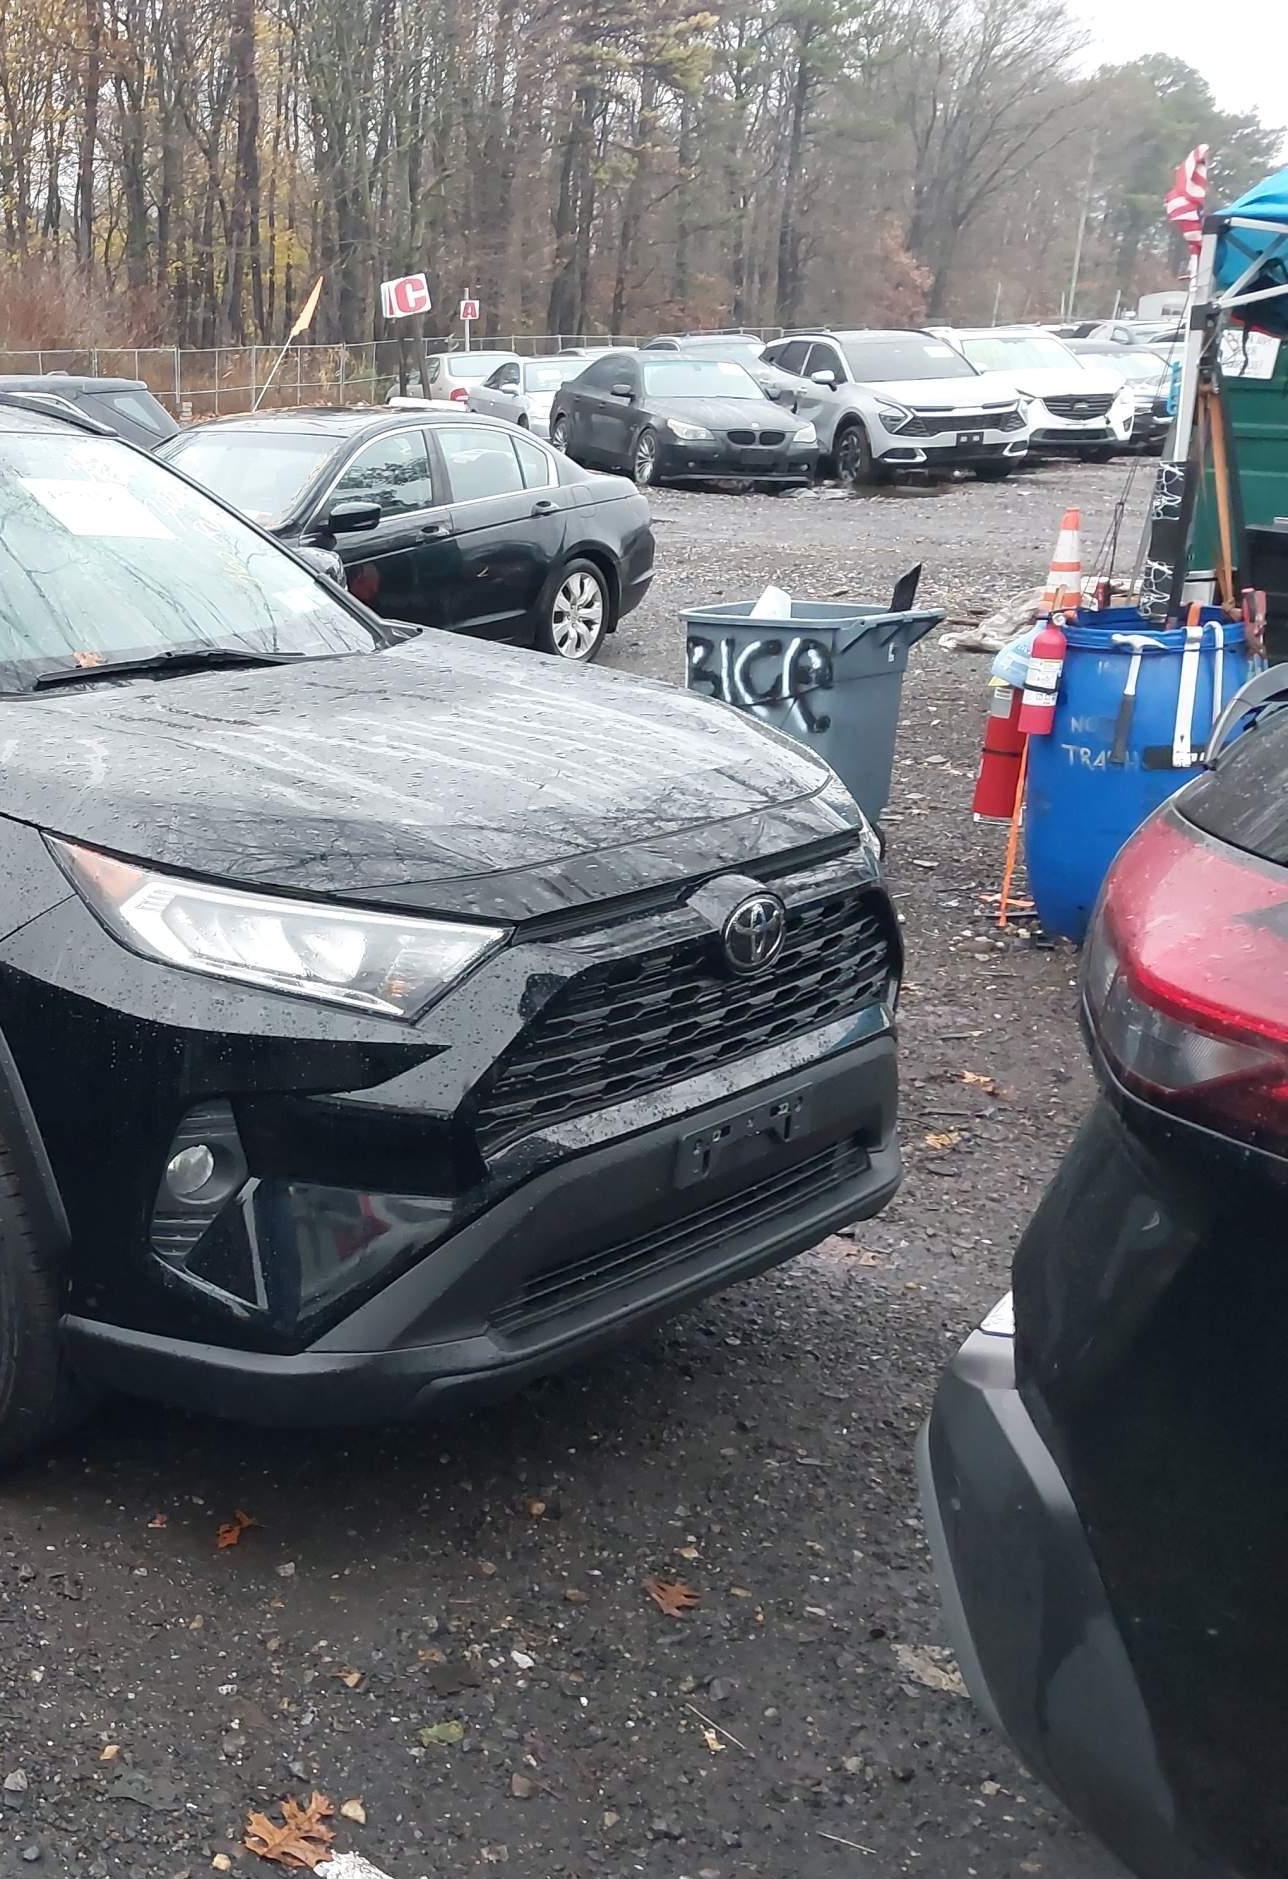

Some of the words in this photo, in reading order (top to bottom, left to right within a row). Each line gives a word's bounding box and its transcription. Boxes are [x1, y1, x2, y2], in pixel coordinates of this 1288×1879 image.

[395, 278, 426, 313] C
[463, 302, 477, 318] A
[1061, 743, 1140, 772] TRAH
